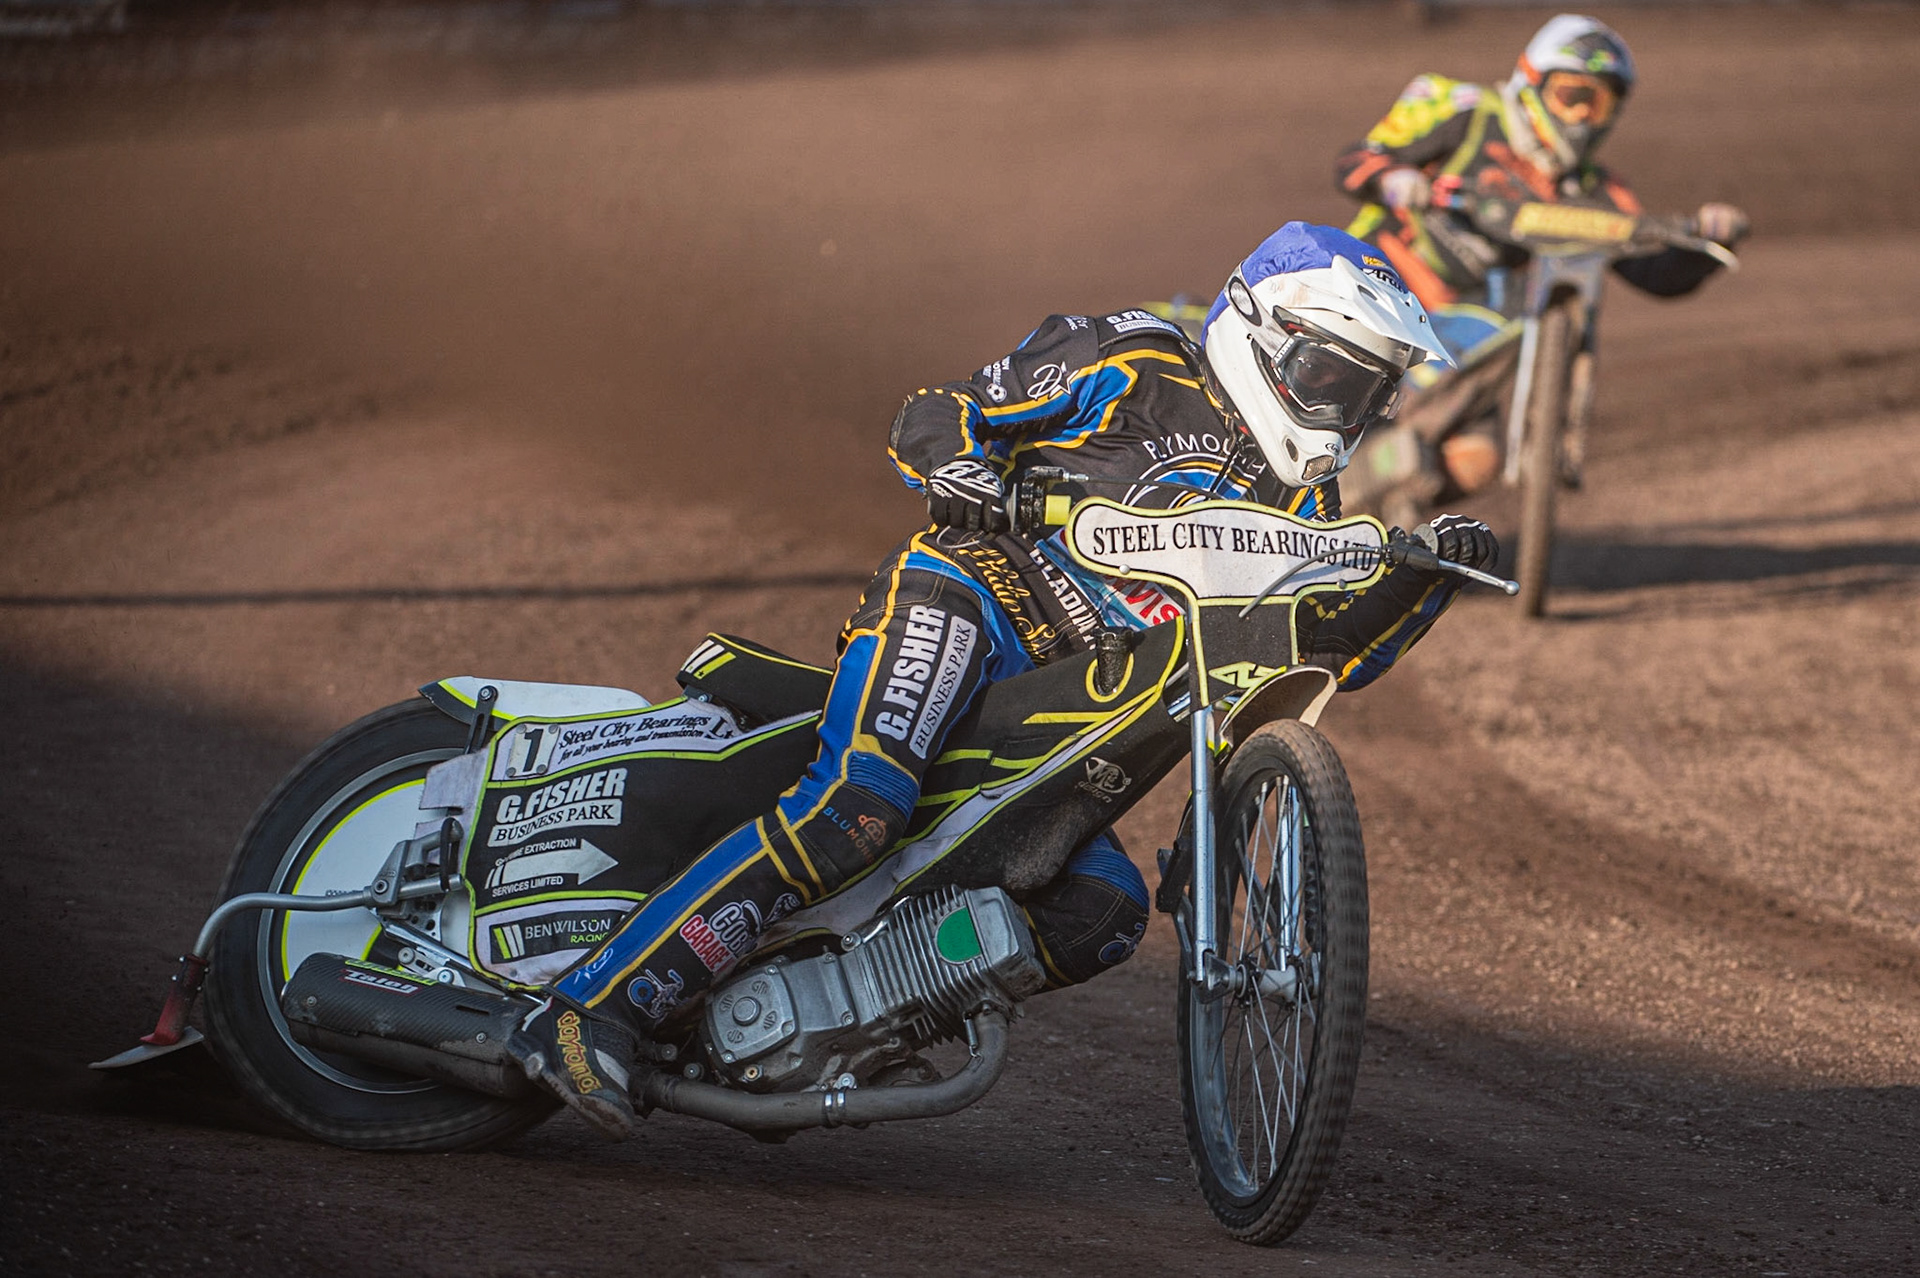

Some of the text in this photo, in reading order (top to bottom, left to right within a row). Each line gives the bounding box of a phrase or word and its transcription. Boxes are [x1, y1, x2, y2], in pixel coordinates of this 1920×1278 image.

[1093, 523, 1167, 556] STEEL
[1172, 521, 1225, 551] CITY
[1231, 528, 1339, 566] BEARINGS
[875, 605, 946, 741] G.FISHER
[915, 624, 971, 750] BUSINESS PARK
[524, 728, 544, 773] 1
[558, 726, 598, 749] Steel
[600, 722, 636, 739] City
[637, 715, 712, 733] Bearings
[496, 767, 628, 824] G.FISHER
[494, 804, 615, 842] BUSINESS PARK
[524, 838, 577, 855] EXTRACTION
[492, 875, 564, 897] SERVICES LIMITED
[680, 914, 732, 973] GARAGE
[557, 1010, 601, 1094] daytona
